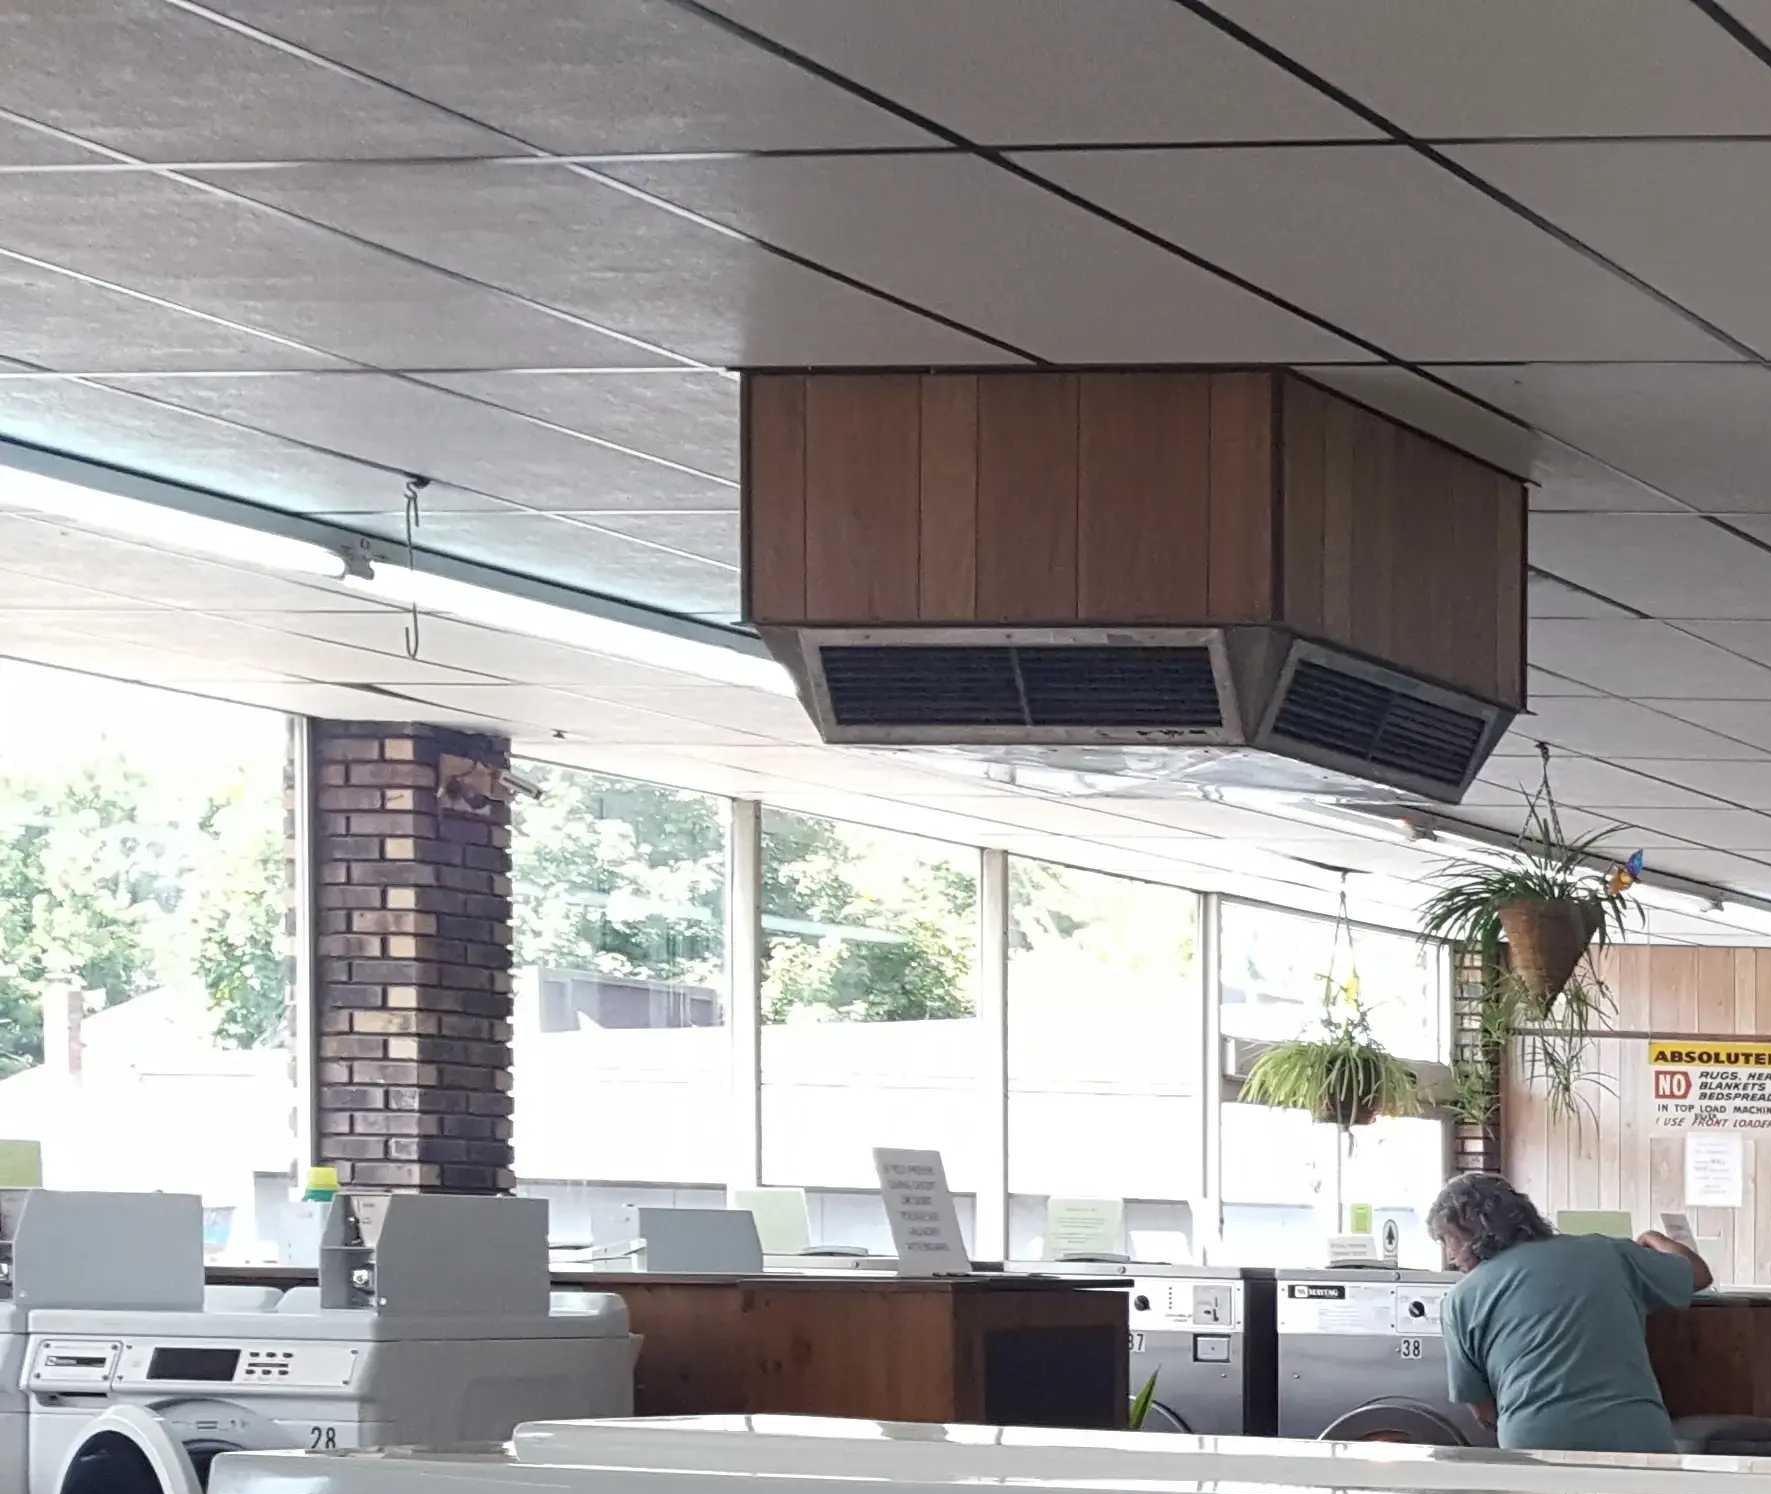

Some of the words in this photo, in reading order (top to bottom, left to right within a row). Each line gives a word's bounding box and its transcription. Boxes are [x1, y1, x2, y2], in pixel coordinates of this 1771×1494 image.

[1658, 1073, 1687, 1097] NO
[1700, 1082, 1766, 1091] BLANKETS
[1658, 1104, 1668, 1112] IN
[1674, 1104, 1695, 1112] TOP
[1700, 1105, 1726, 1113] LOAD
[1403, 1340, 1420, 1357] 38
[310, 1426, 337, 1450] 28
